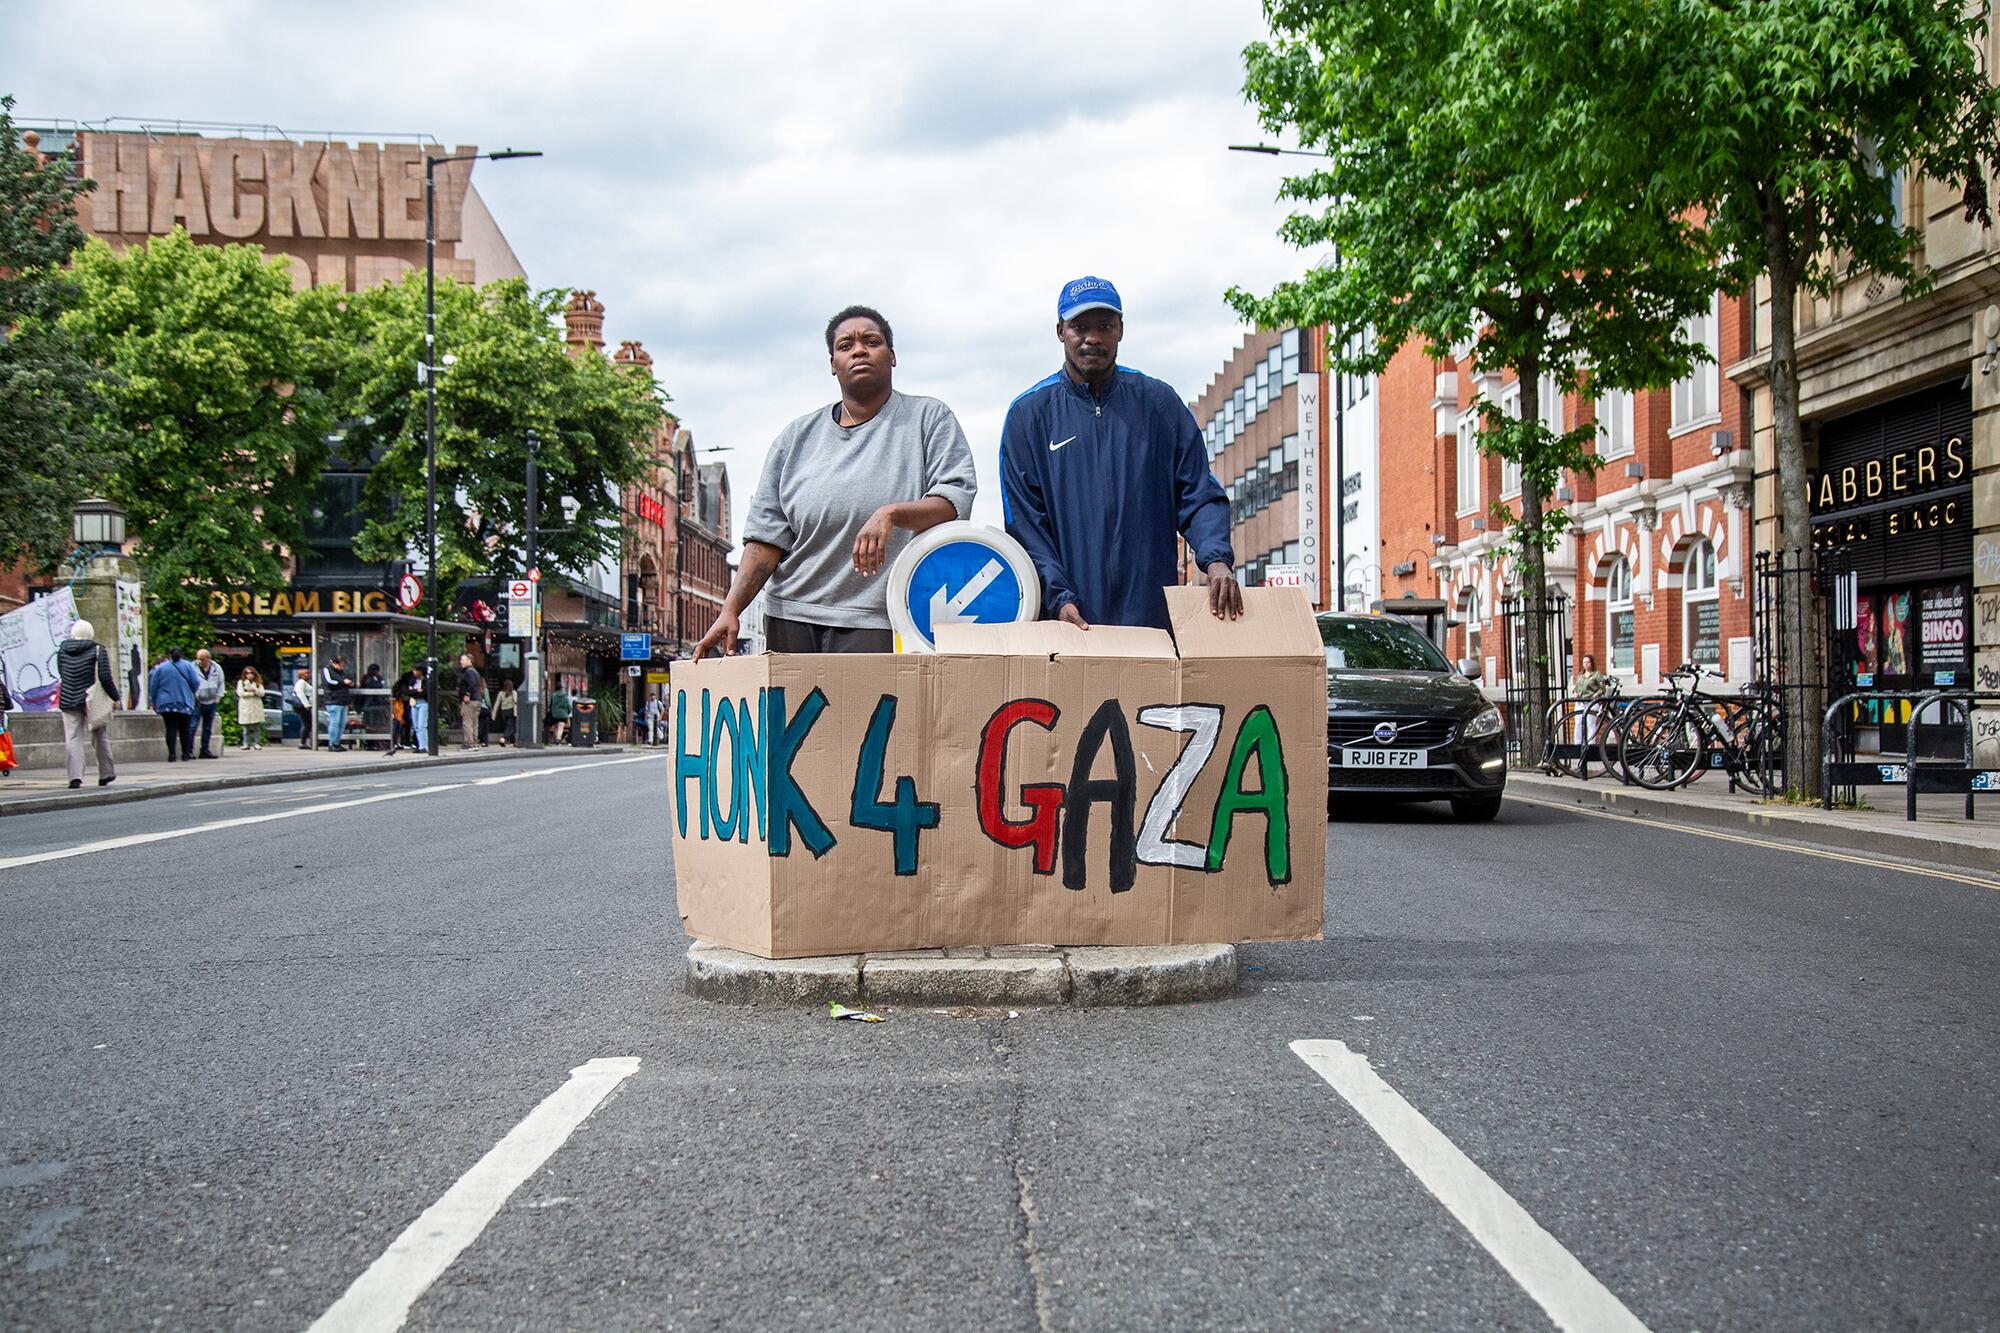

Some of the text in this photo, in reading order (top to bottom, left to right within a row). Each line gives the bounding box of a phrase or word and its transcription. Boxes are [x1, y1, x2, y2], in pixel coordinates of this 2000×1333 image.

[92, 132, 478, 242] HACKNEY
[1301, 393, 1317, 585] WETHERSPOON
[207, 590, 388, 616] DREAM BIG
[1922, 599, 1934, 610] THE
[1934, 597, 1953, 609] HOME
[1953, 596, 1964, 608] OF
[1922, 608, 1964, 620] CONTEMPORARY
[1922, 619, 1964, 643] BINGO
[1351, 751, 1418, 766] RJ18 FZP
[676, 686, 1292, 894] HONK 4 GAZA
